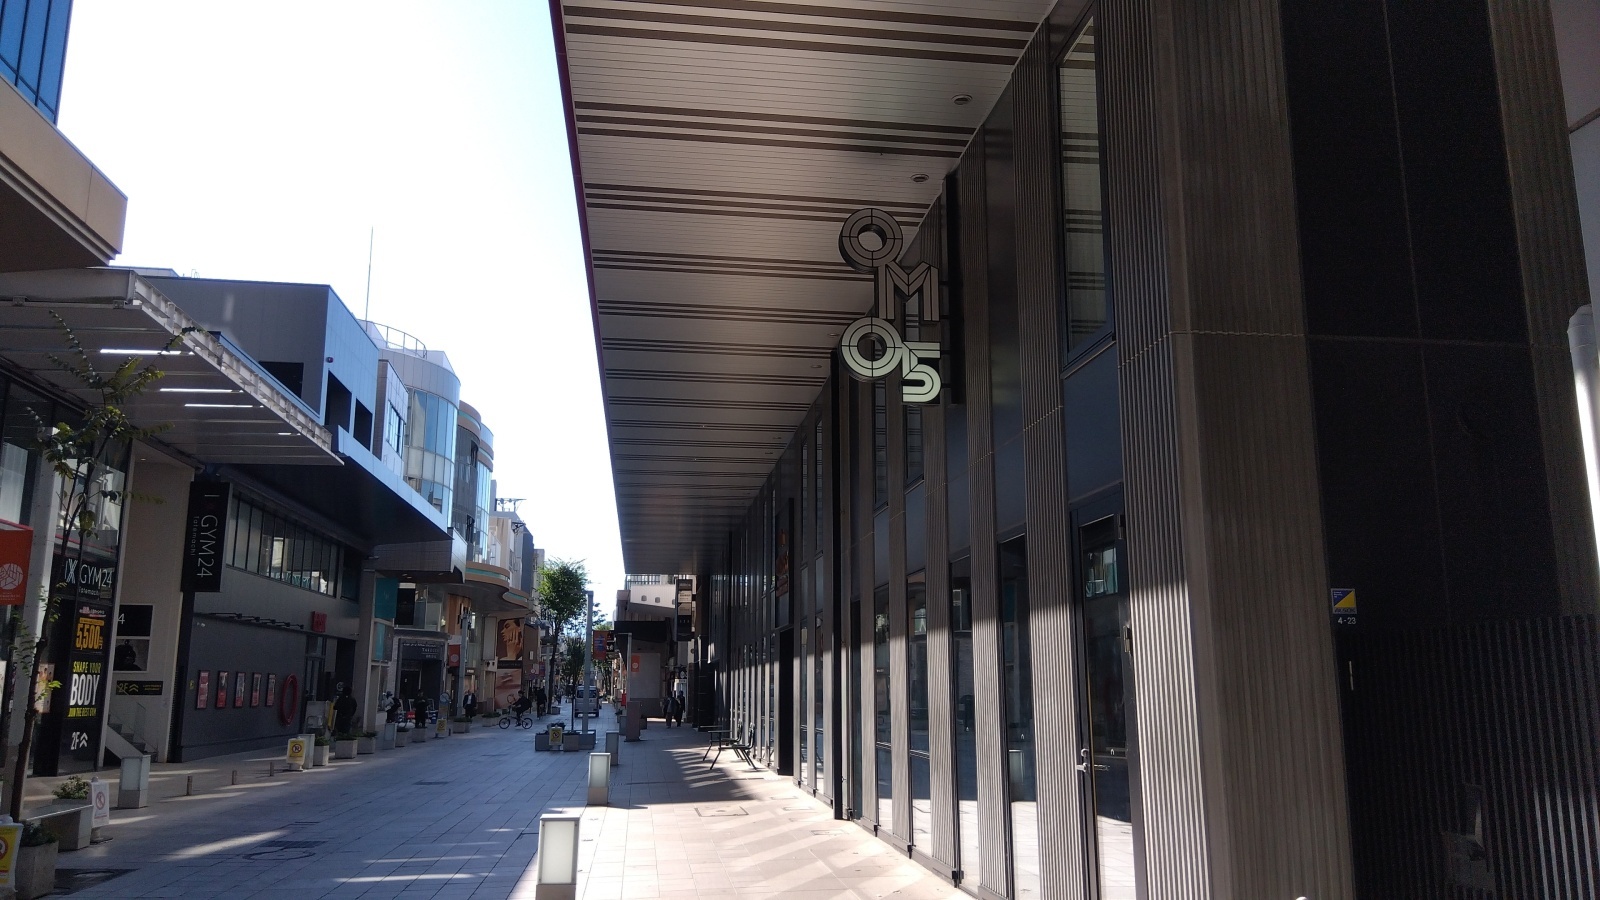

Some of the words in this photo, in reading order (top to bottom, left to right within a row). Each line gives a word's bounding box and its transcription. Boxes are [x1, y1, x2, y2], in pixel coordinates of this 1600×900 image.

[190, 516, 200, 556] Tatemachi
[196, 515, 218, 578] GYM24
[1338, 617, 1356, 625] 4-23
[70, 674, 100, 705] BODY
[71, 731, 81, 750] 2F
